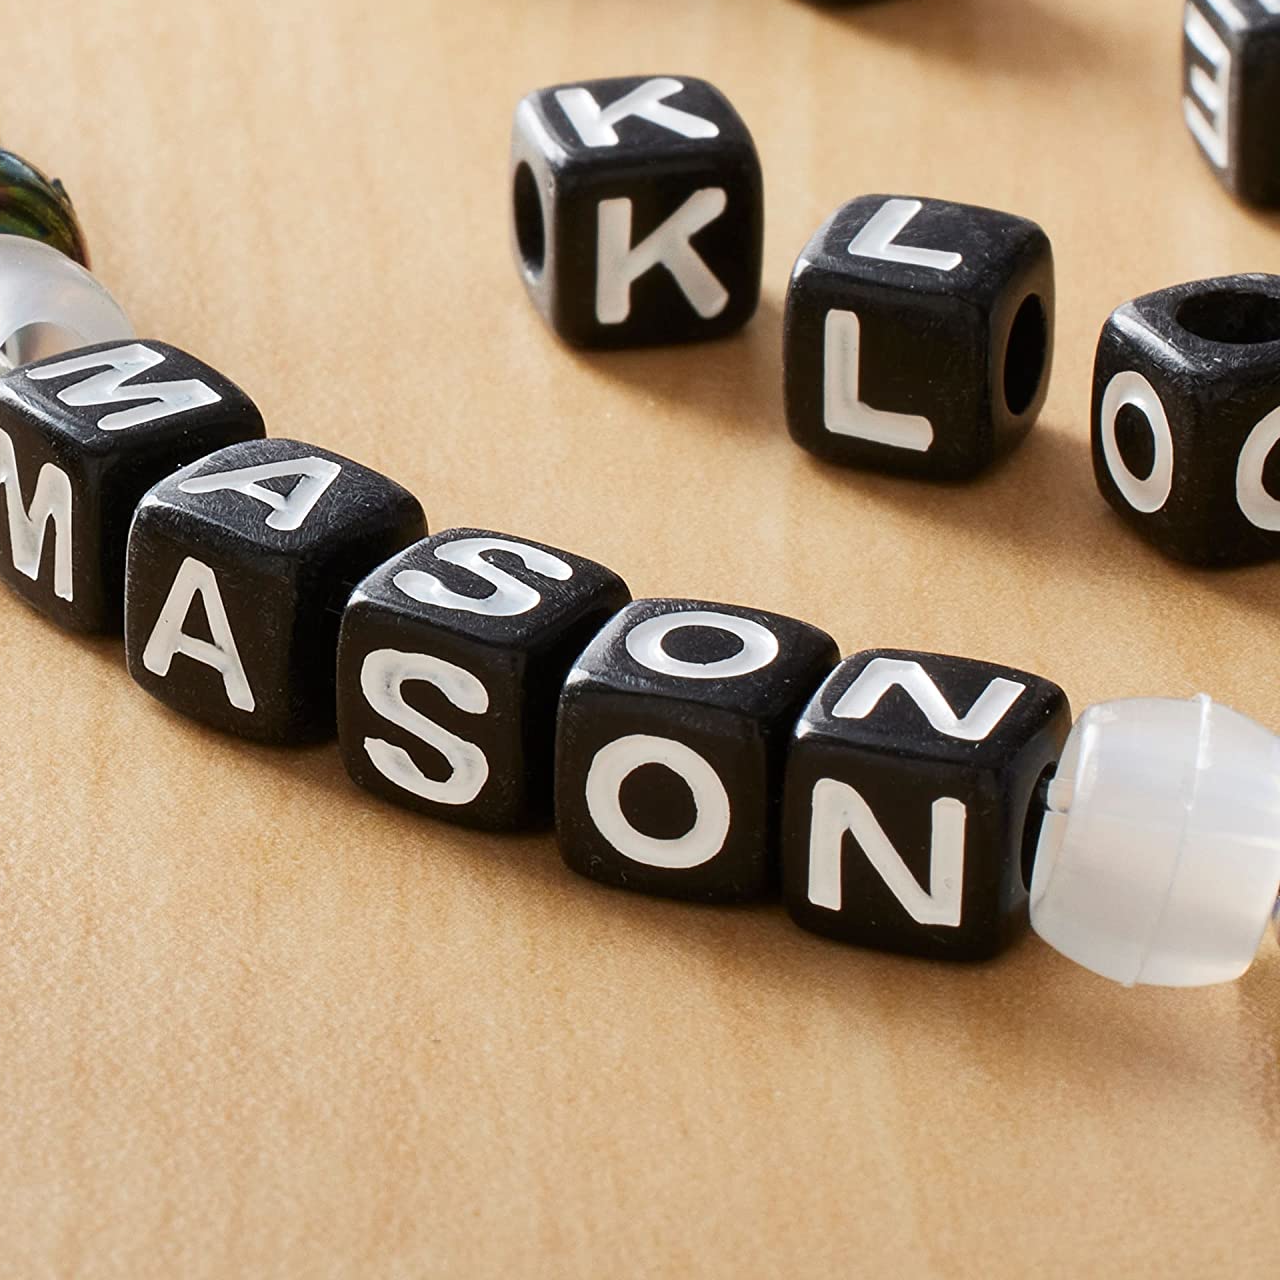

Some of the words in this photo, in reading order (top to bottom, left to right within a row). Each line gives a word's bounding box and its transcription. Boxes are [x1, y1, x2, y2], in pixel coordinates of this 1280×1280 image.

[554, 77, 719, 147] K
[597, 187, 729, 324] K
[848, 198, 962, 271] L
[824, 309, 934, 452] L
[1100, 371, 1174, 513] O
